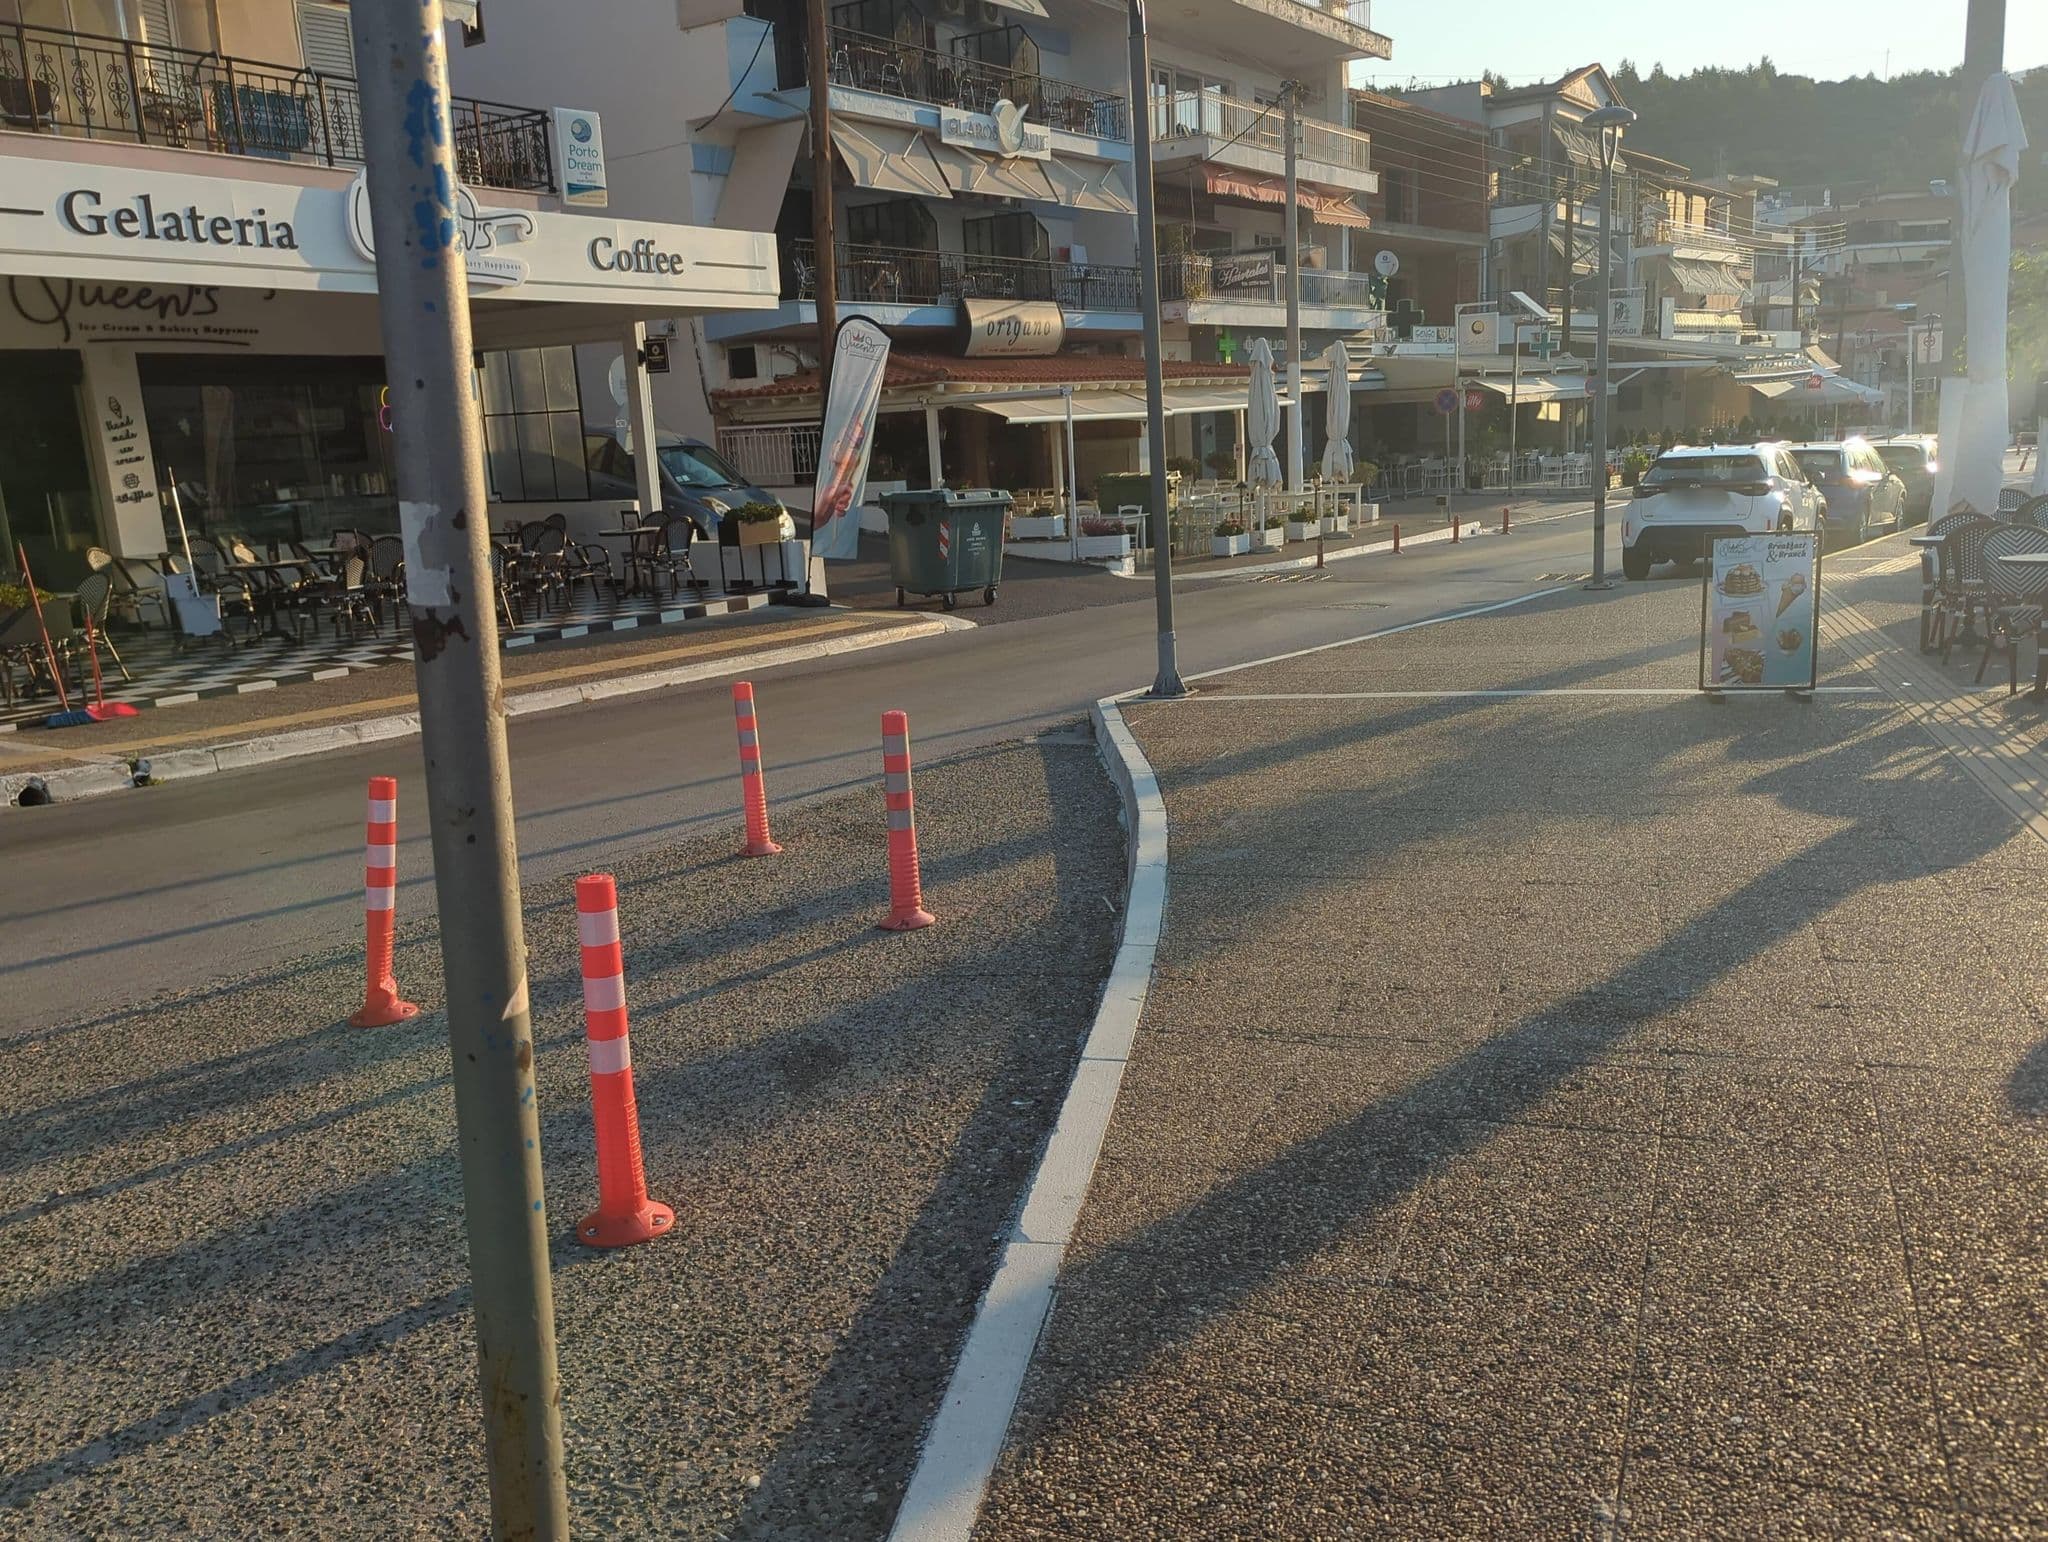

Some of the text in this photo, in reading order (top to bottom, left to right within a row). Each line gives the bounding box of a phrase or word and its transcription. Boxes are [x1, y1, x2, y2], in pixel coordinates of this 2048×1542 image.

[569, 144, 599, 158] Porto
[568, 158, 602, 171] Dream
[58, 189, 299, 250] Gelateria
[588, 236, 685, 276] Coffee
[79, 322, 97, 332] Ice
[103, 323, 140, 332] Cream
[159, 324, 199, 335] Bakery
[203, 325, 260, 336] Happiness
[987, 320, 1051, 346] origano
[1767, 542, 1807, 551] Breakfast
[1779, 549, 1807, 559] Brunch
